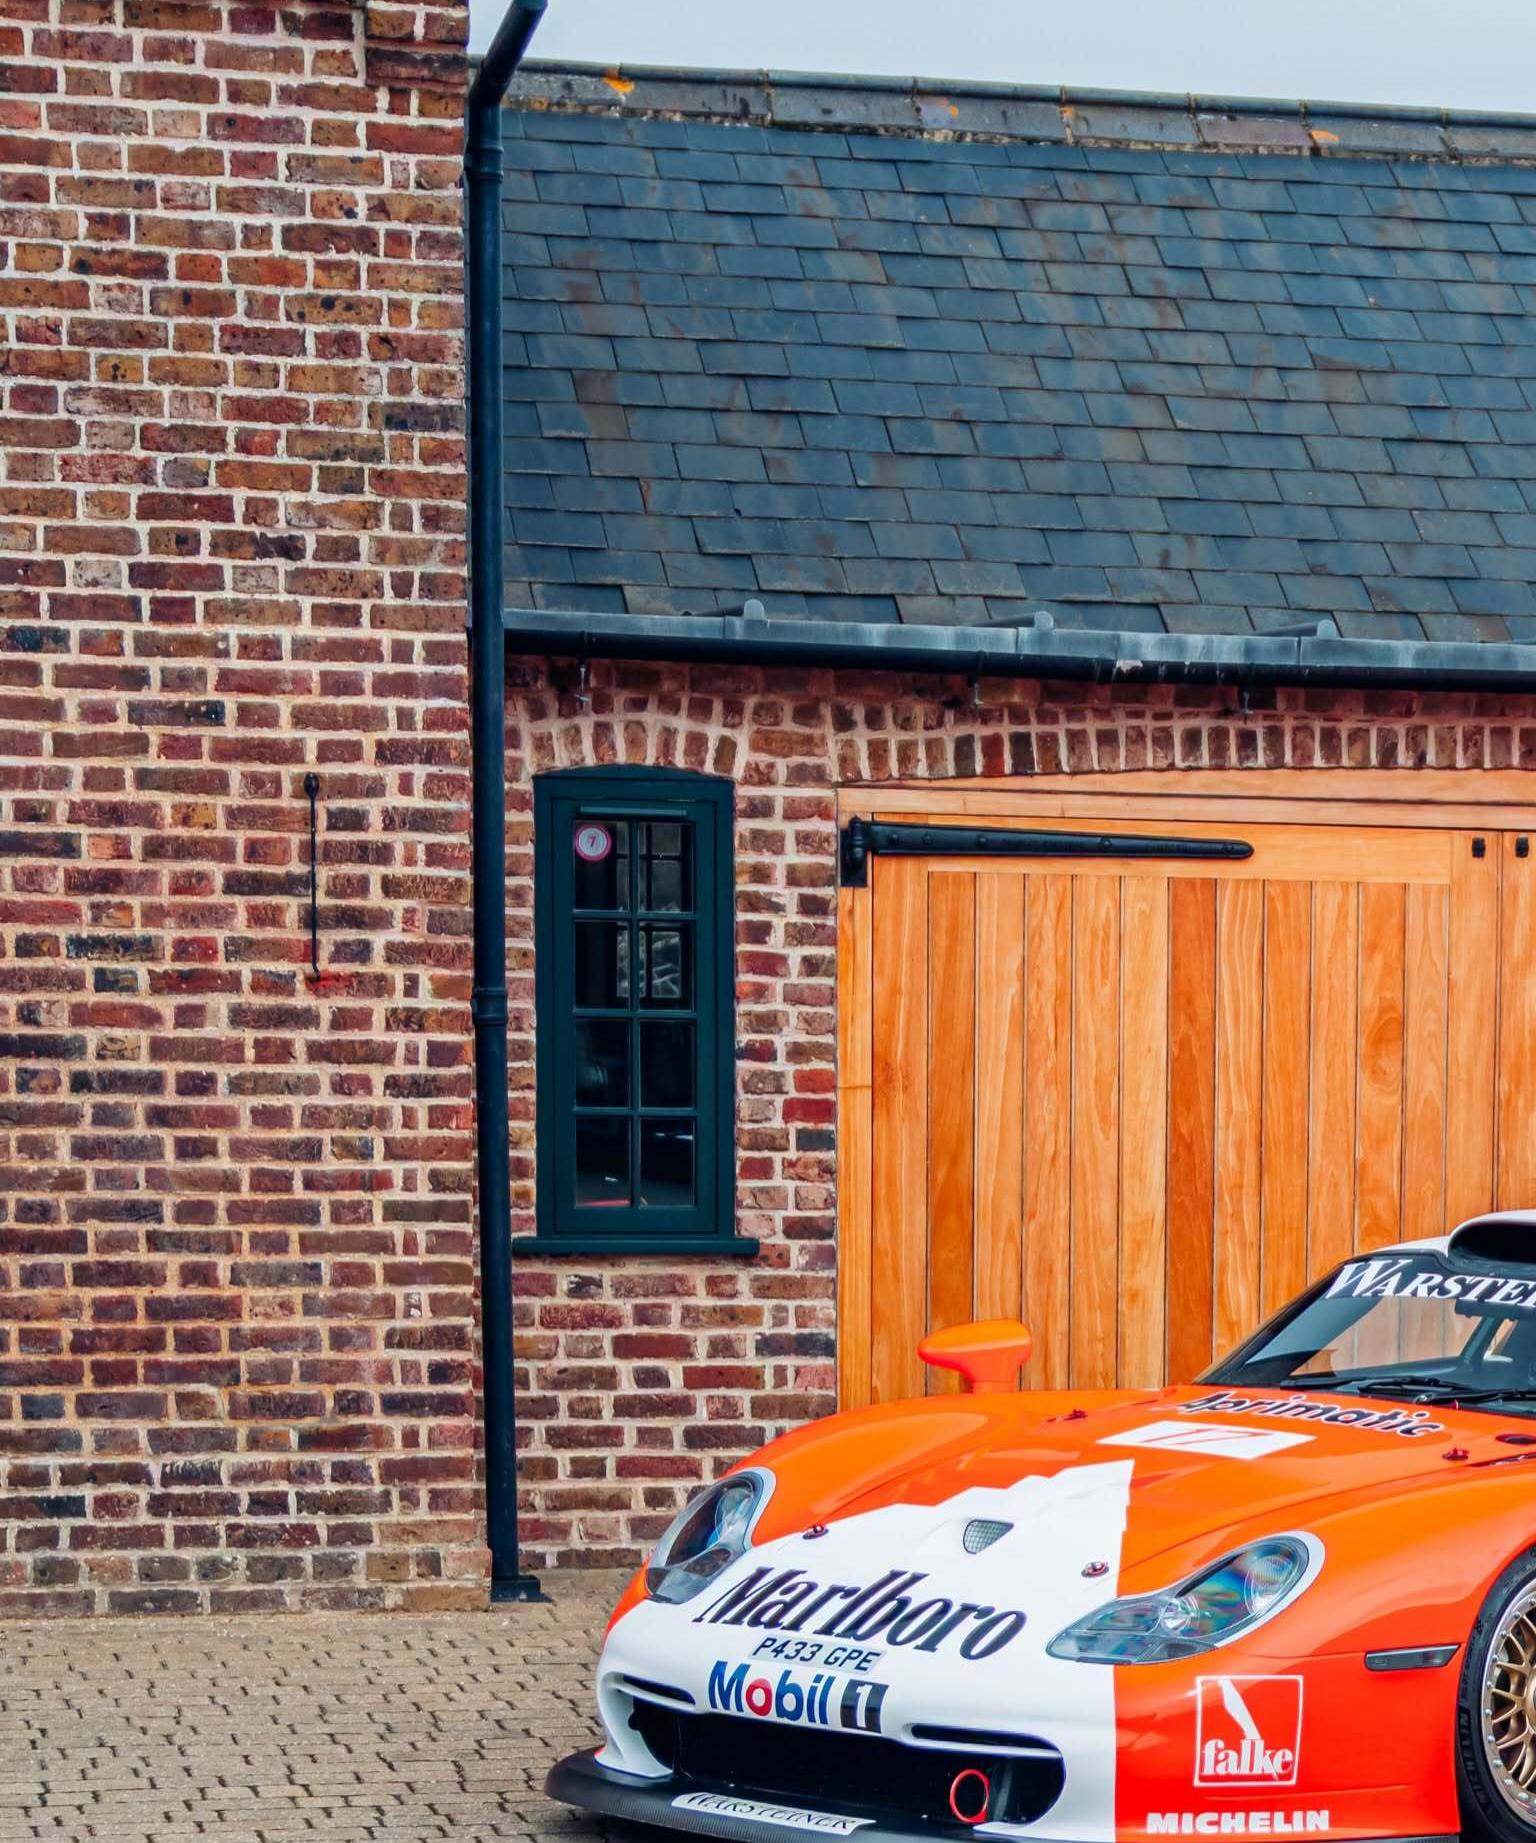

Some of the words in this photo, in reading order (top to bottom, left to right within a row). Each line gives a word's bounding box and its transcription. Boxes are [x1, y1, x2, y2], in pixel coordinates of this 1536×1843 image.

[692, 1567, 1029, 1660] Marlboro
[752, 1637, 823, 1661] P433
[824, 1647, 880, 1671] GPE
[708, 1661, 837, 1725] Mobil
[1201, 1739, 1294, 1782] falke
[1146, 1810, 1330, 1835] MICHELIN
